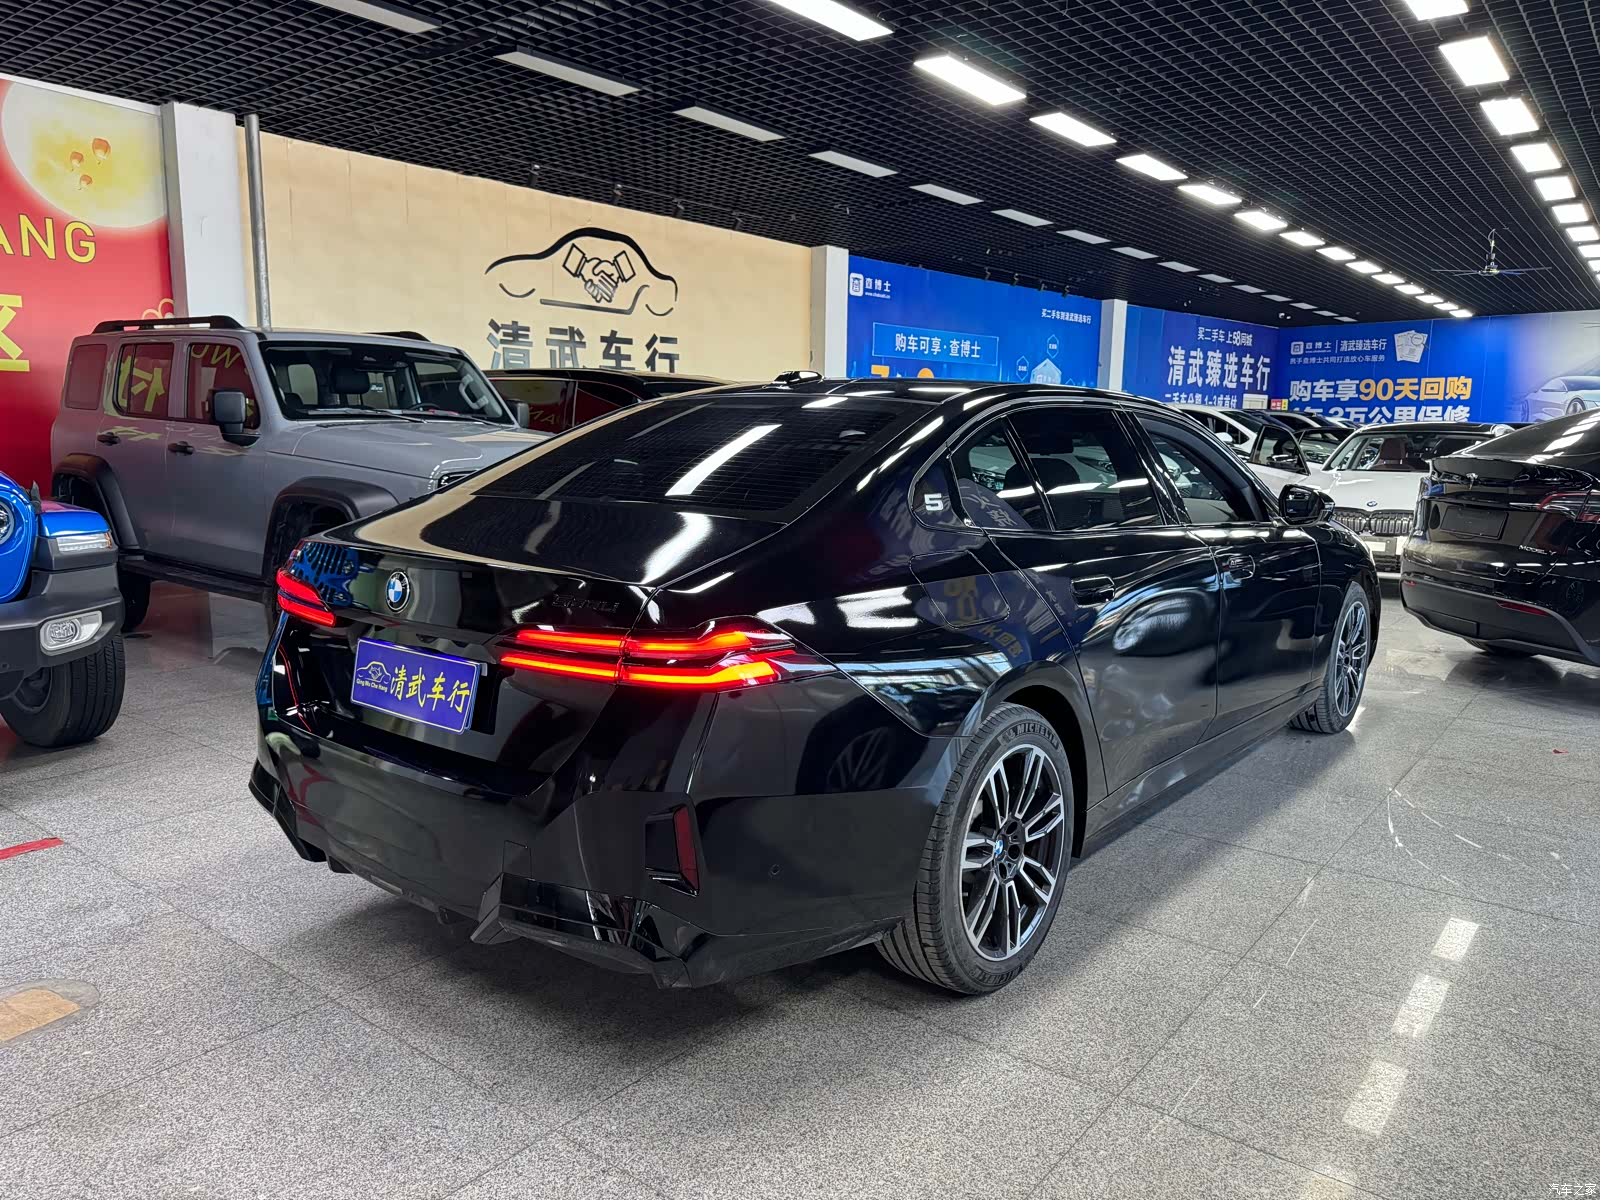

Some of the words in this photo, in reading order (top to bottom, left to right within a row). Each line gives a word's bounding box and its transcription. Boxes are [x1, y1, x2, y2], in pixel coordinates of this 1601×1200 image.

[486, 318, 680, 374] 清武车行
[1167, 344, 1271, 391] 清武臻选车行
[1289, 376, 1473, 402] 购车享90天回购
[924, 493, 944, 511] 5
[390, 664, 470, 713] 清武车行
[1017, 722, 1061, 750] MICHELIN
